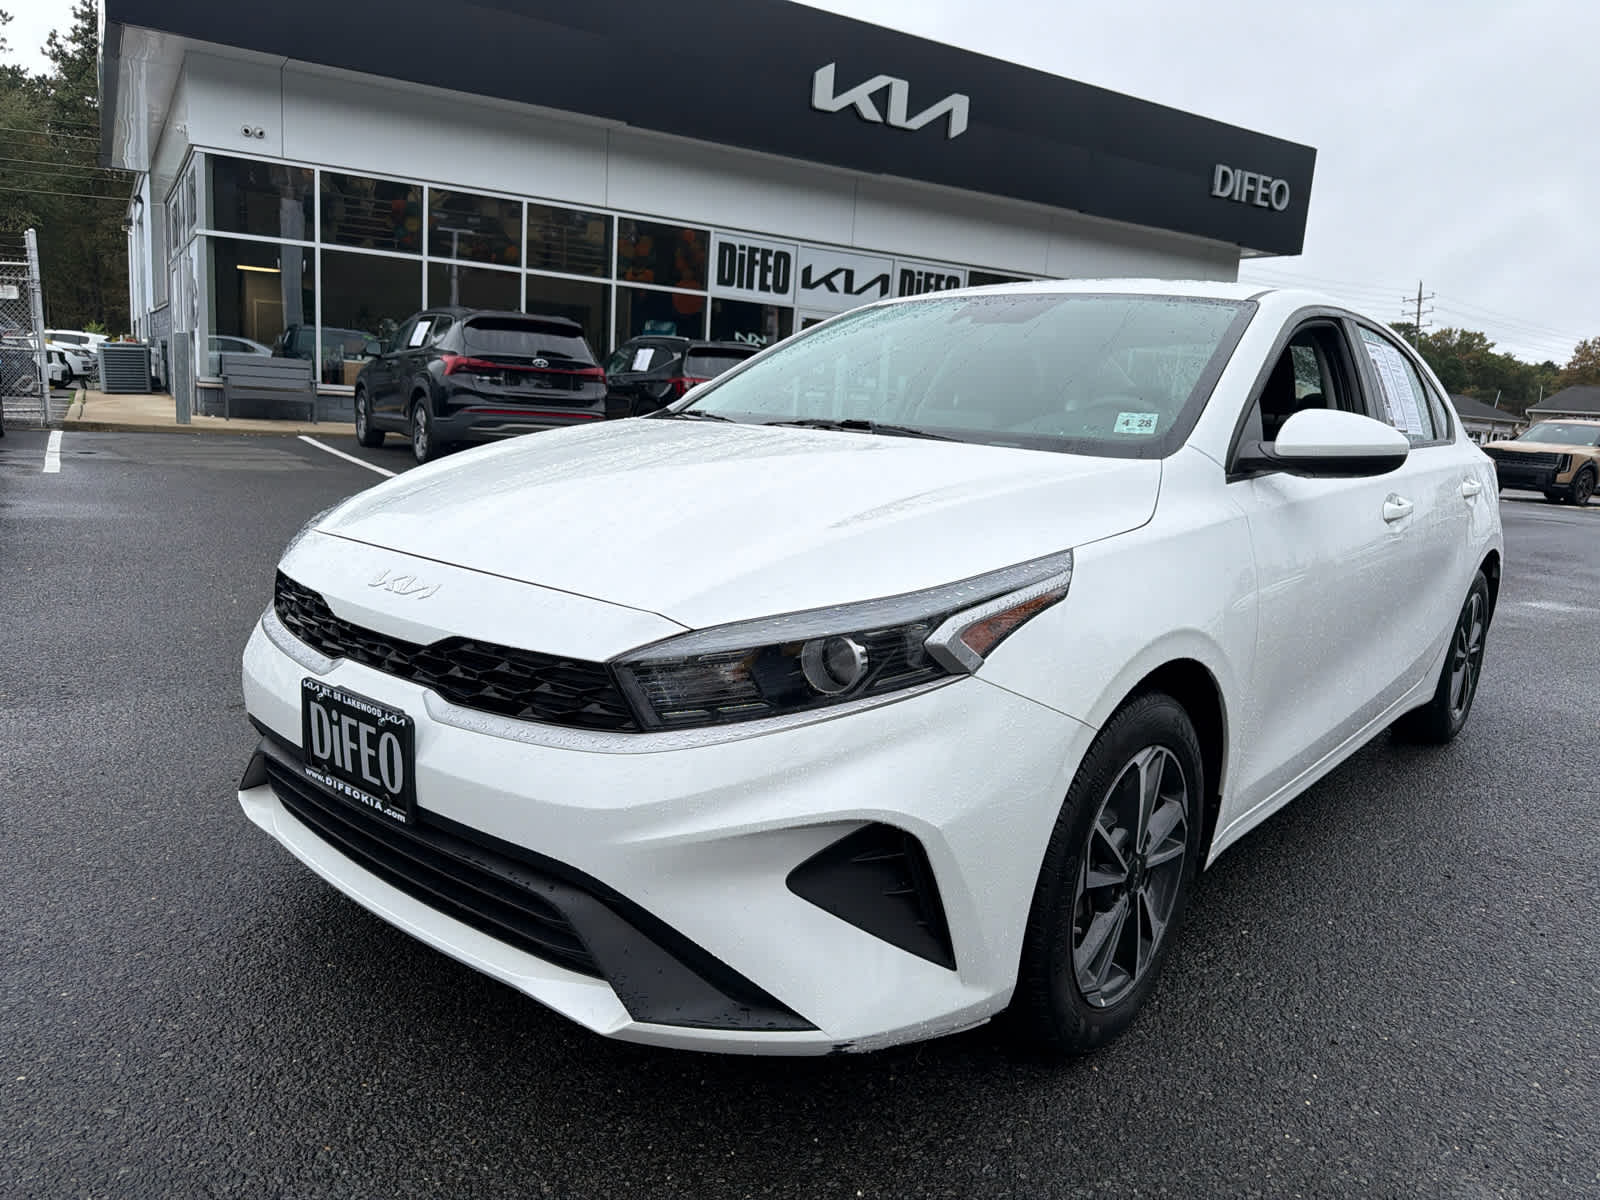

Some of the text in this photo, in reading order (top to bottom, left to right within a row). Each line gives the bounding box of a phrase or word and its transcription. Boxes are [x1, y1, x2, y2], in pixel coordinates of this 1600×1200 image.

[812, 62, 969, 139] KIA
[1211, 164, 1290, 211] DIFEO
[716, 241, 792, 295] DiFEO
[343, 696, 382, 717] LAKEWOOD
[310, 701, 404, 794] DiFEO
